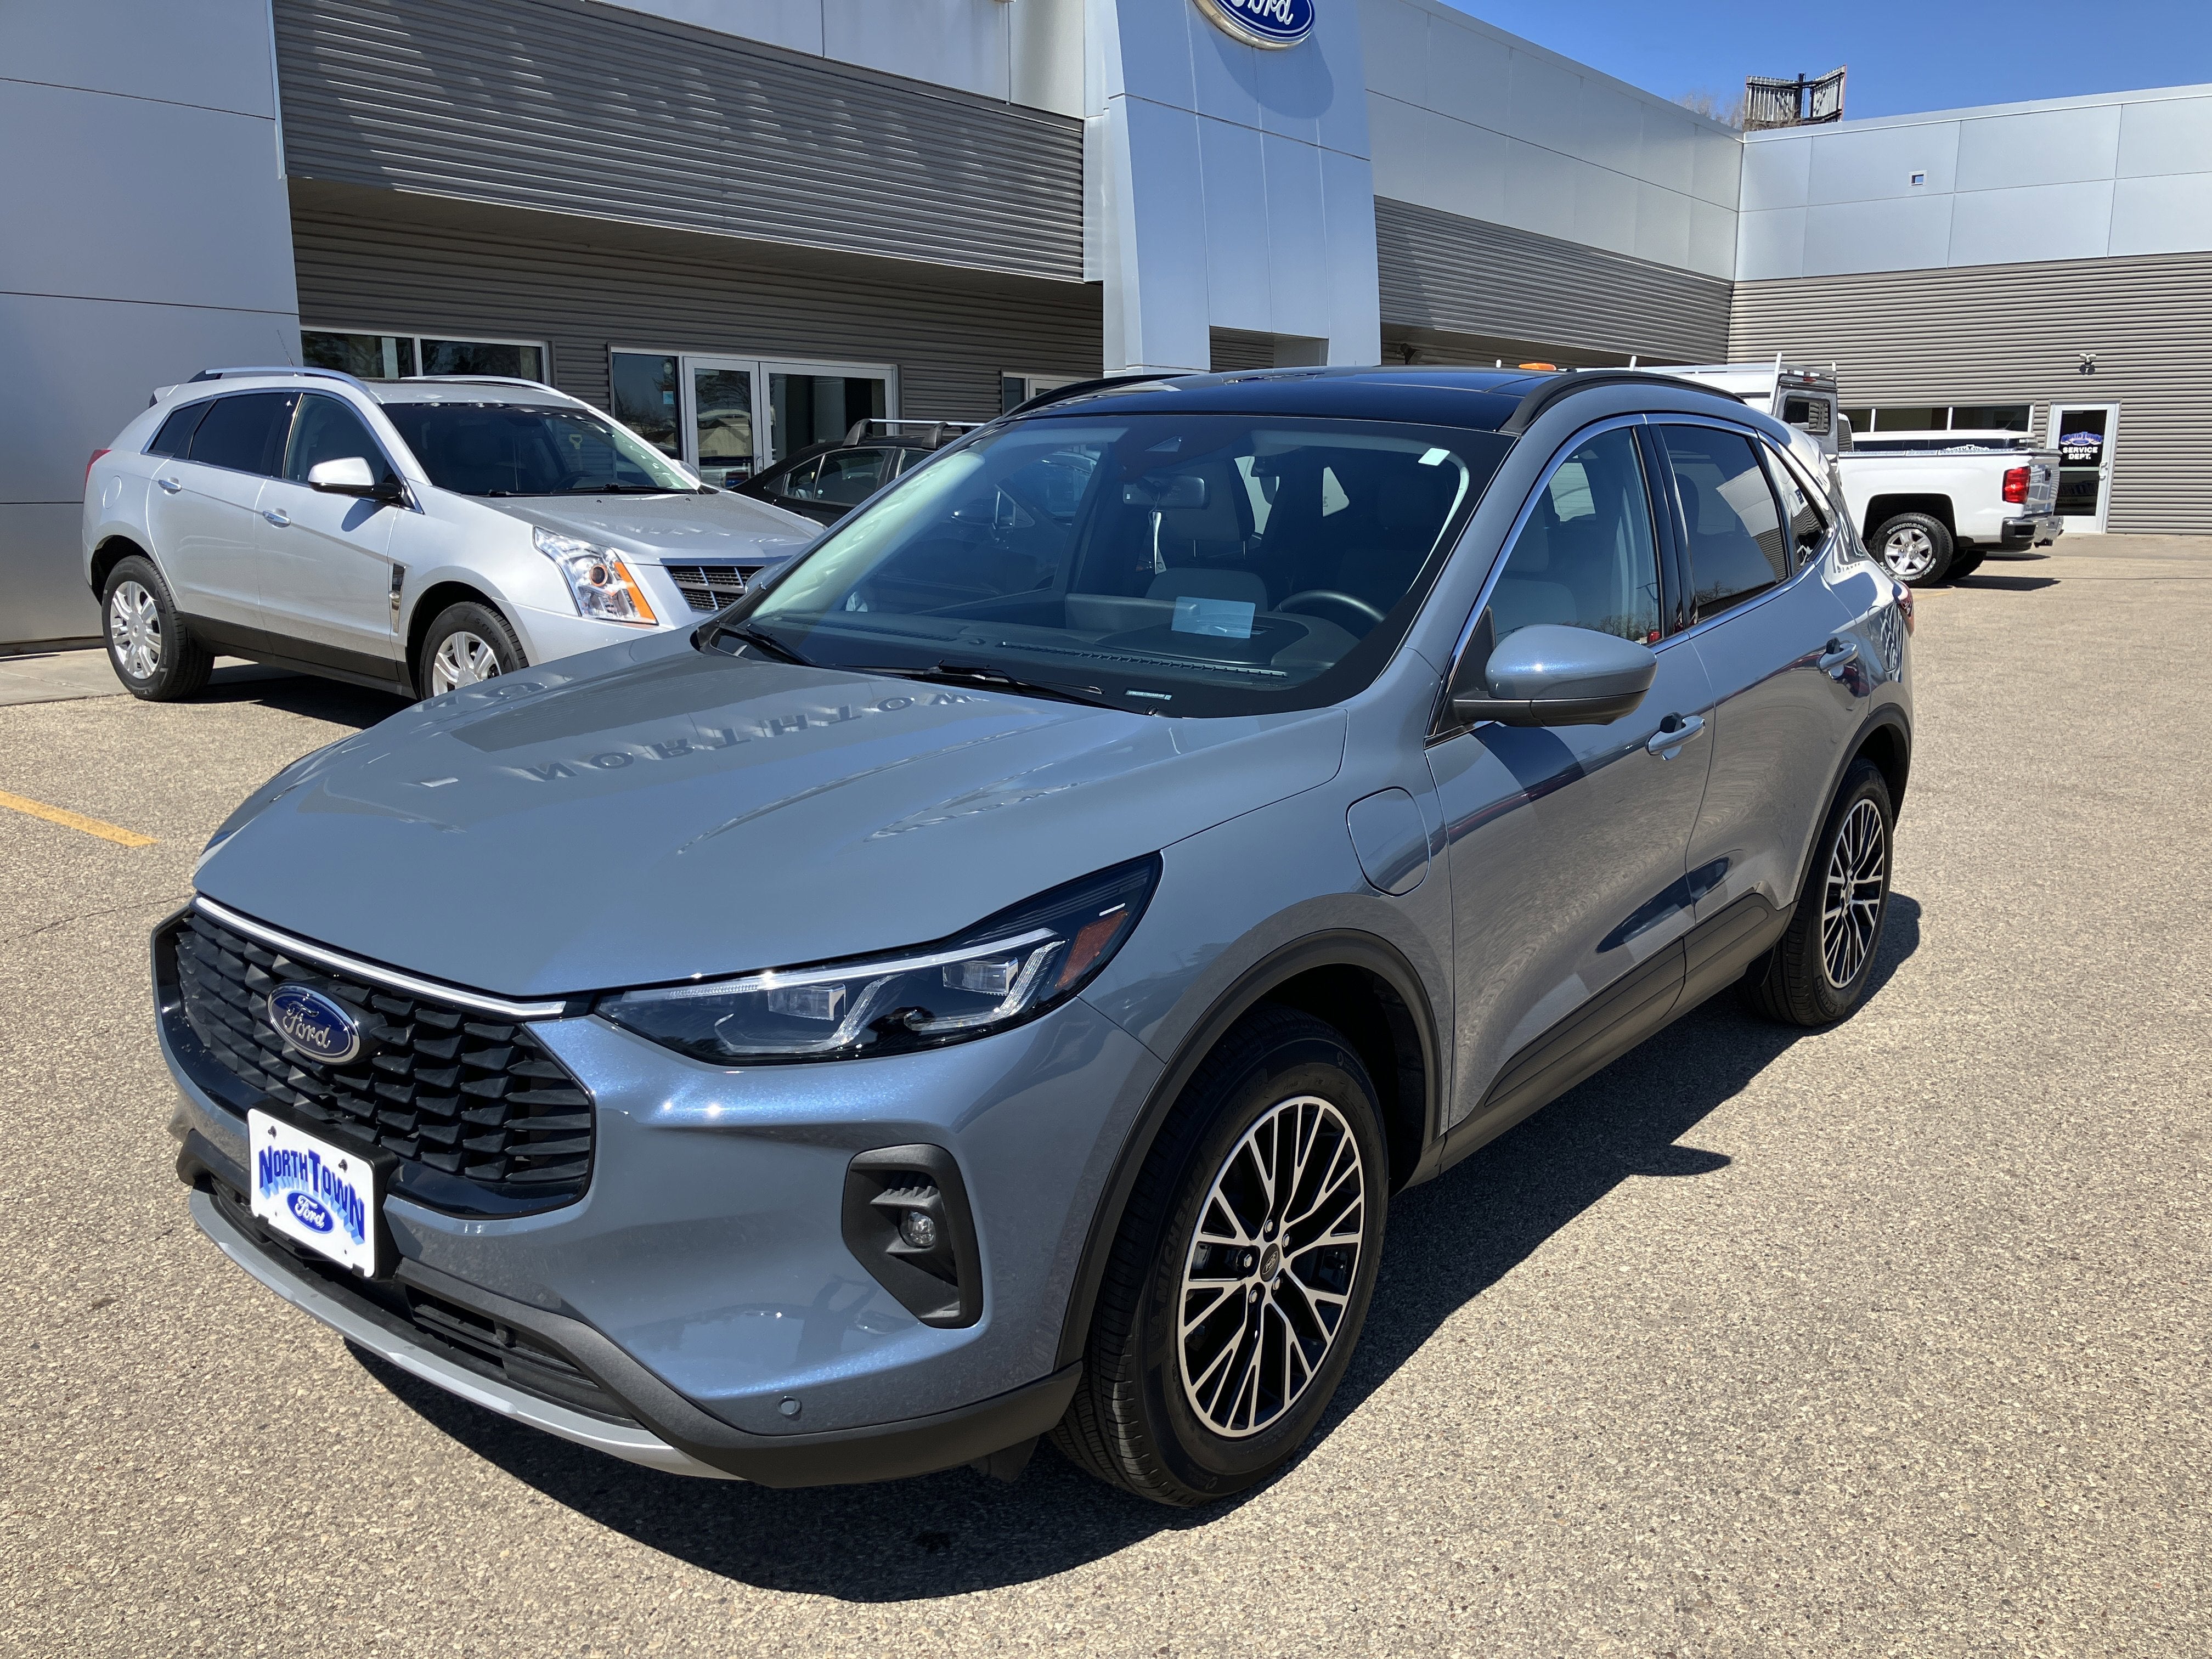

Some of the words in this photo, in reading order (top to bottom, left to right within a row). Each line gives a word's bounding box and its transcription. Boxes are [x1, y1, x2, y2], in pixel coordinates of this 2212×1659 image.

[1231, 0, 1294, 25] ord
[283, 1001, 331, 1049] Ford
[295, 1195, 325, 1229] Ford
[1155, 1160, 1207, 1302] MICHELIN
